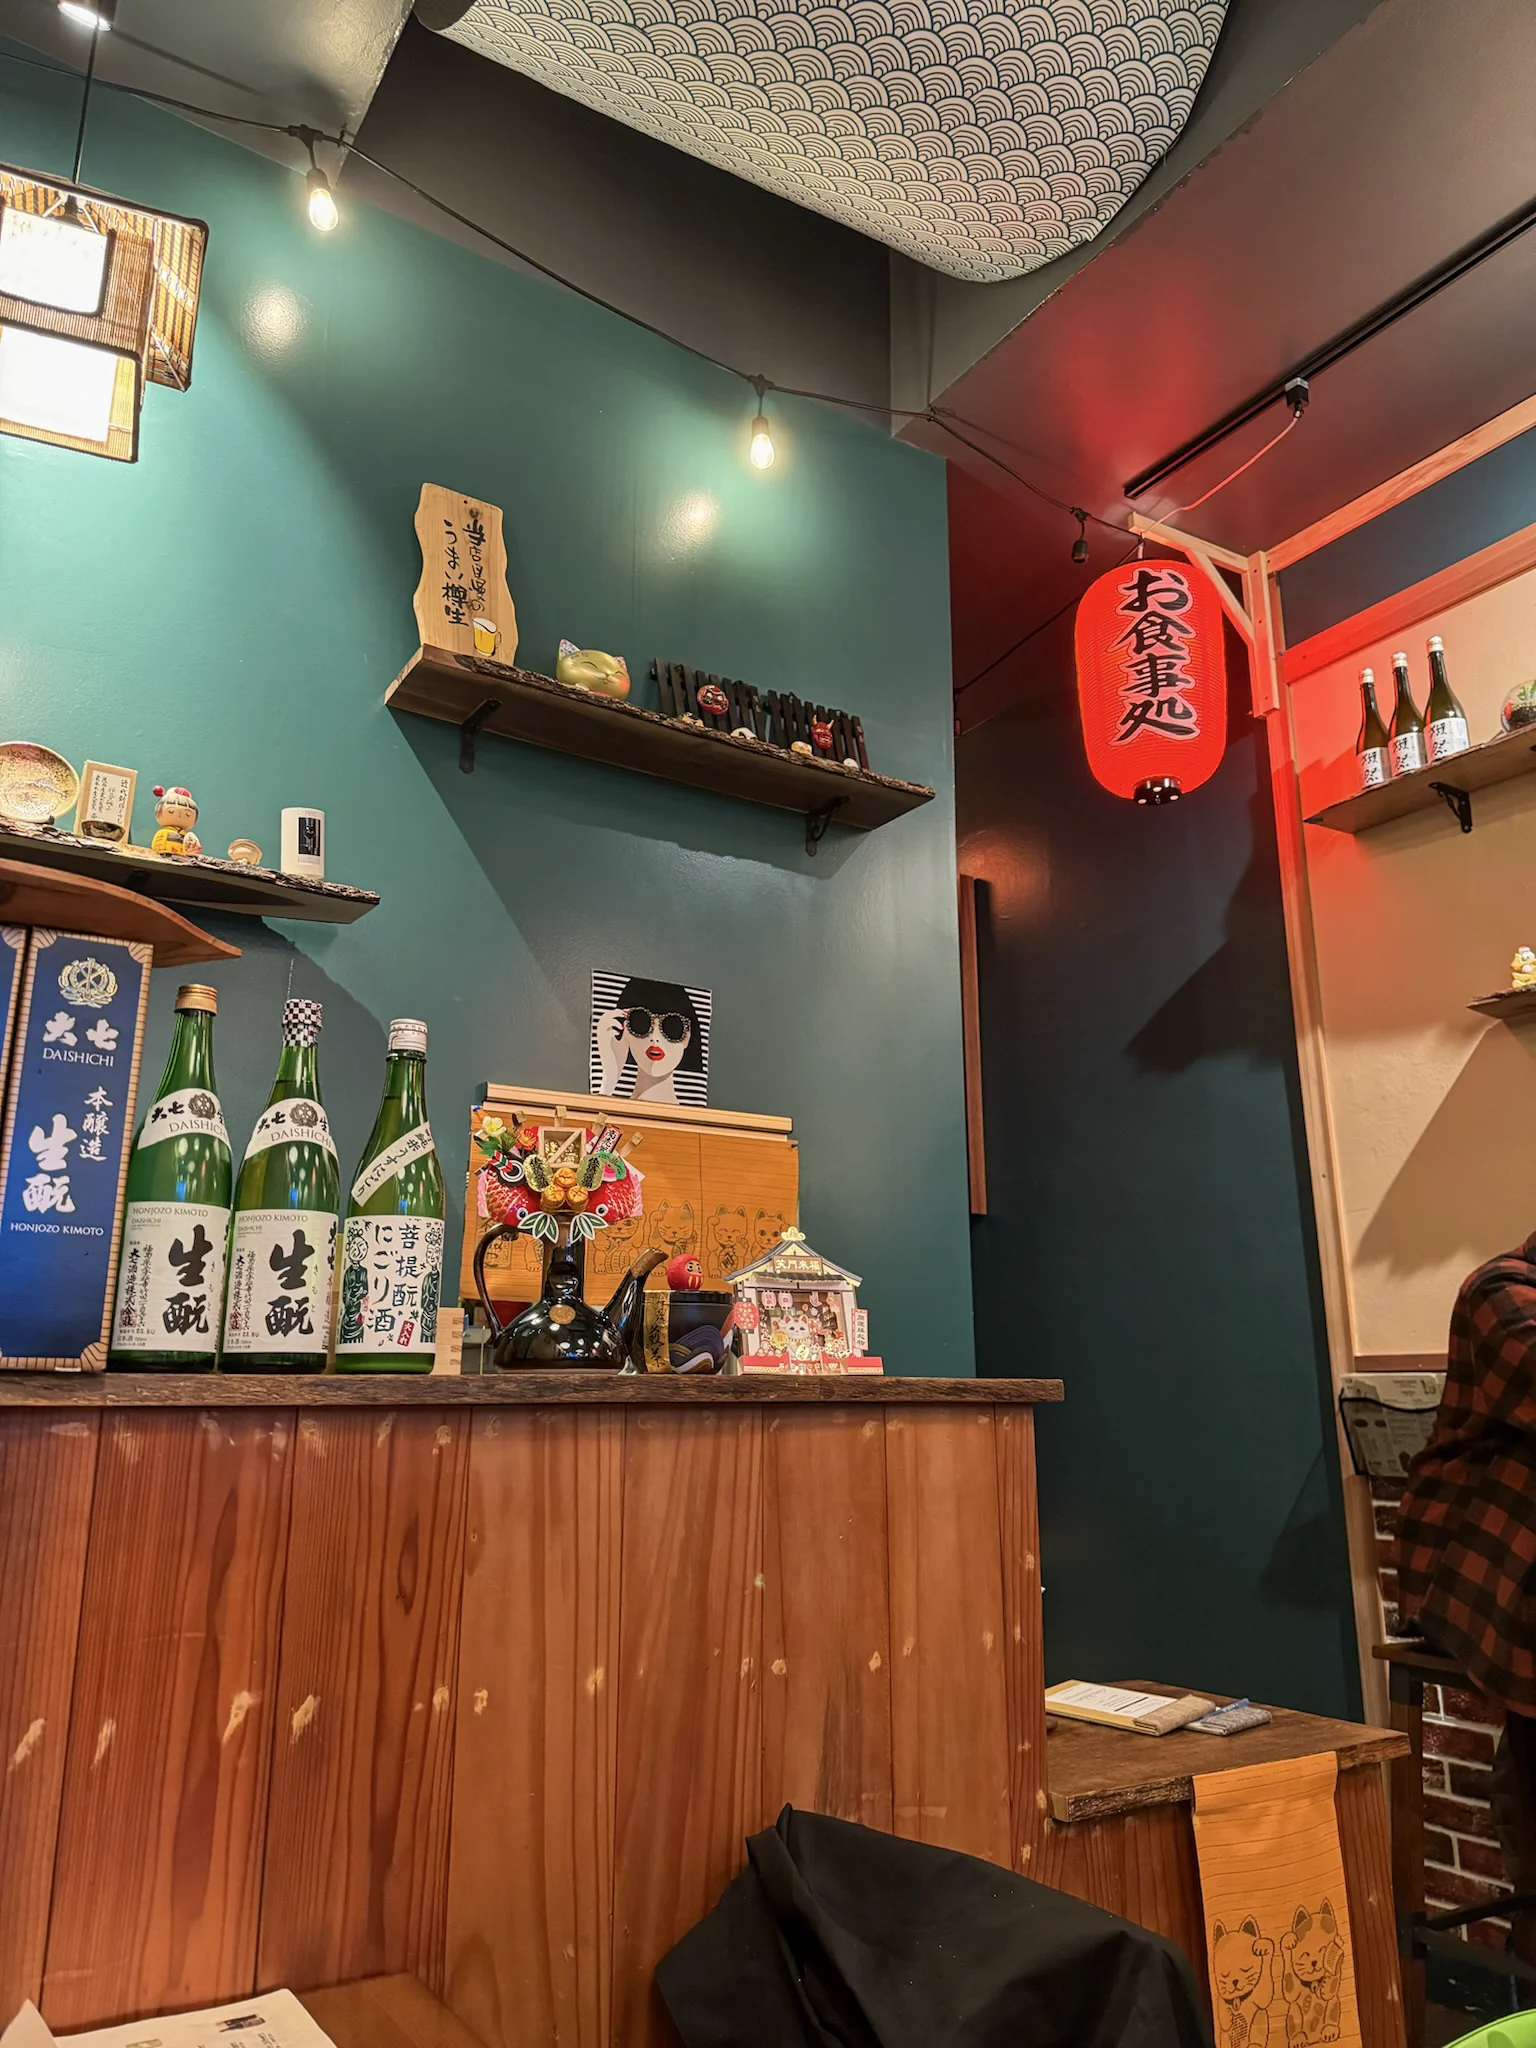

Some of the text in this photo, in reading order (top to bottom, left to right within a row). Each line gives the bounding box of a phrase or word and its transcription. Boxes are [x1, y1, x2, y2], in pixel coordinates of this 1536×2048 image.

[1114, 570, 1197, 742] お食事処
[42, 1047, 114, 1067] DAISHICHI
[79, 1085, 114, 1162] 本醸造
[270, 1127, 331, 1148] DAISHICHI
[22, 1113, 78, 1214] 生酛
[10, 1222, 104, 1237] HONJOZO KIMOTO
[132, 1207, 209, 1217] HONJOZO KIMOTO
[238, 1214, 309, 1223] HONJOZO KIMOTO
[162, 1223, 214, 1336] 生酛
[265, 1228, 316, 1338] 生酛
[365, 1224, 399, 1333] にごり酒
[391, 1223, 421, 1308] 菩提酛
[775, 1259, 821, 1271] 笑門来福
[399, 1323, 413, 1346] 火入れ
